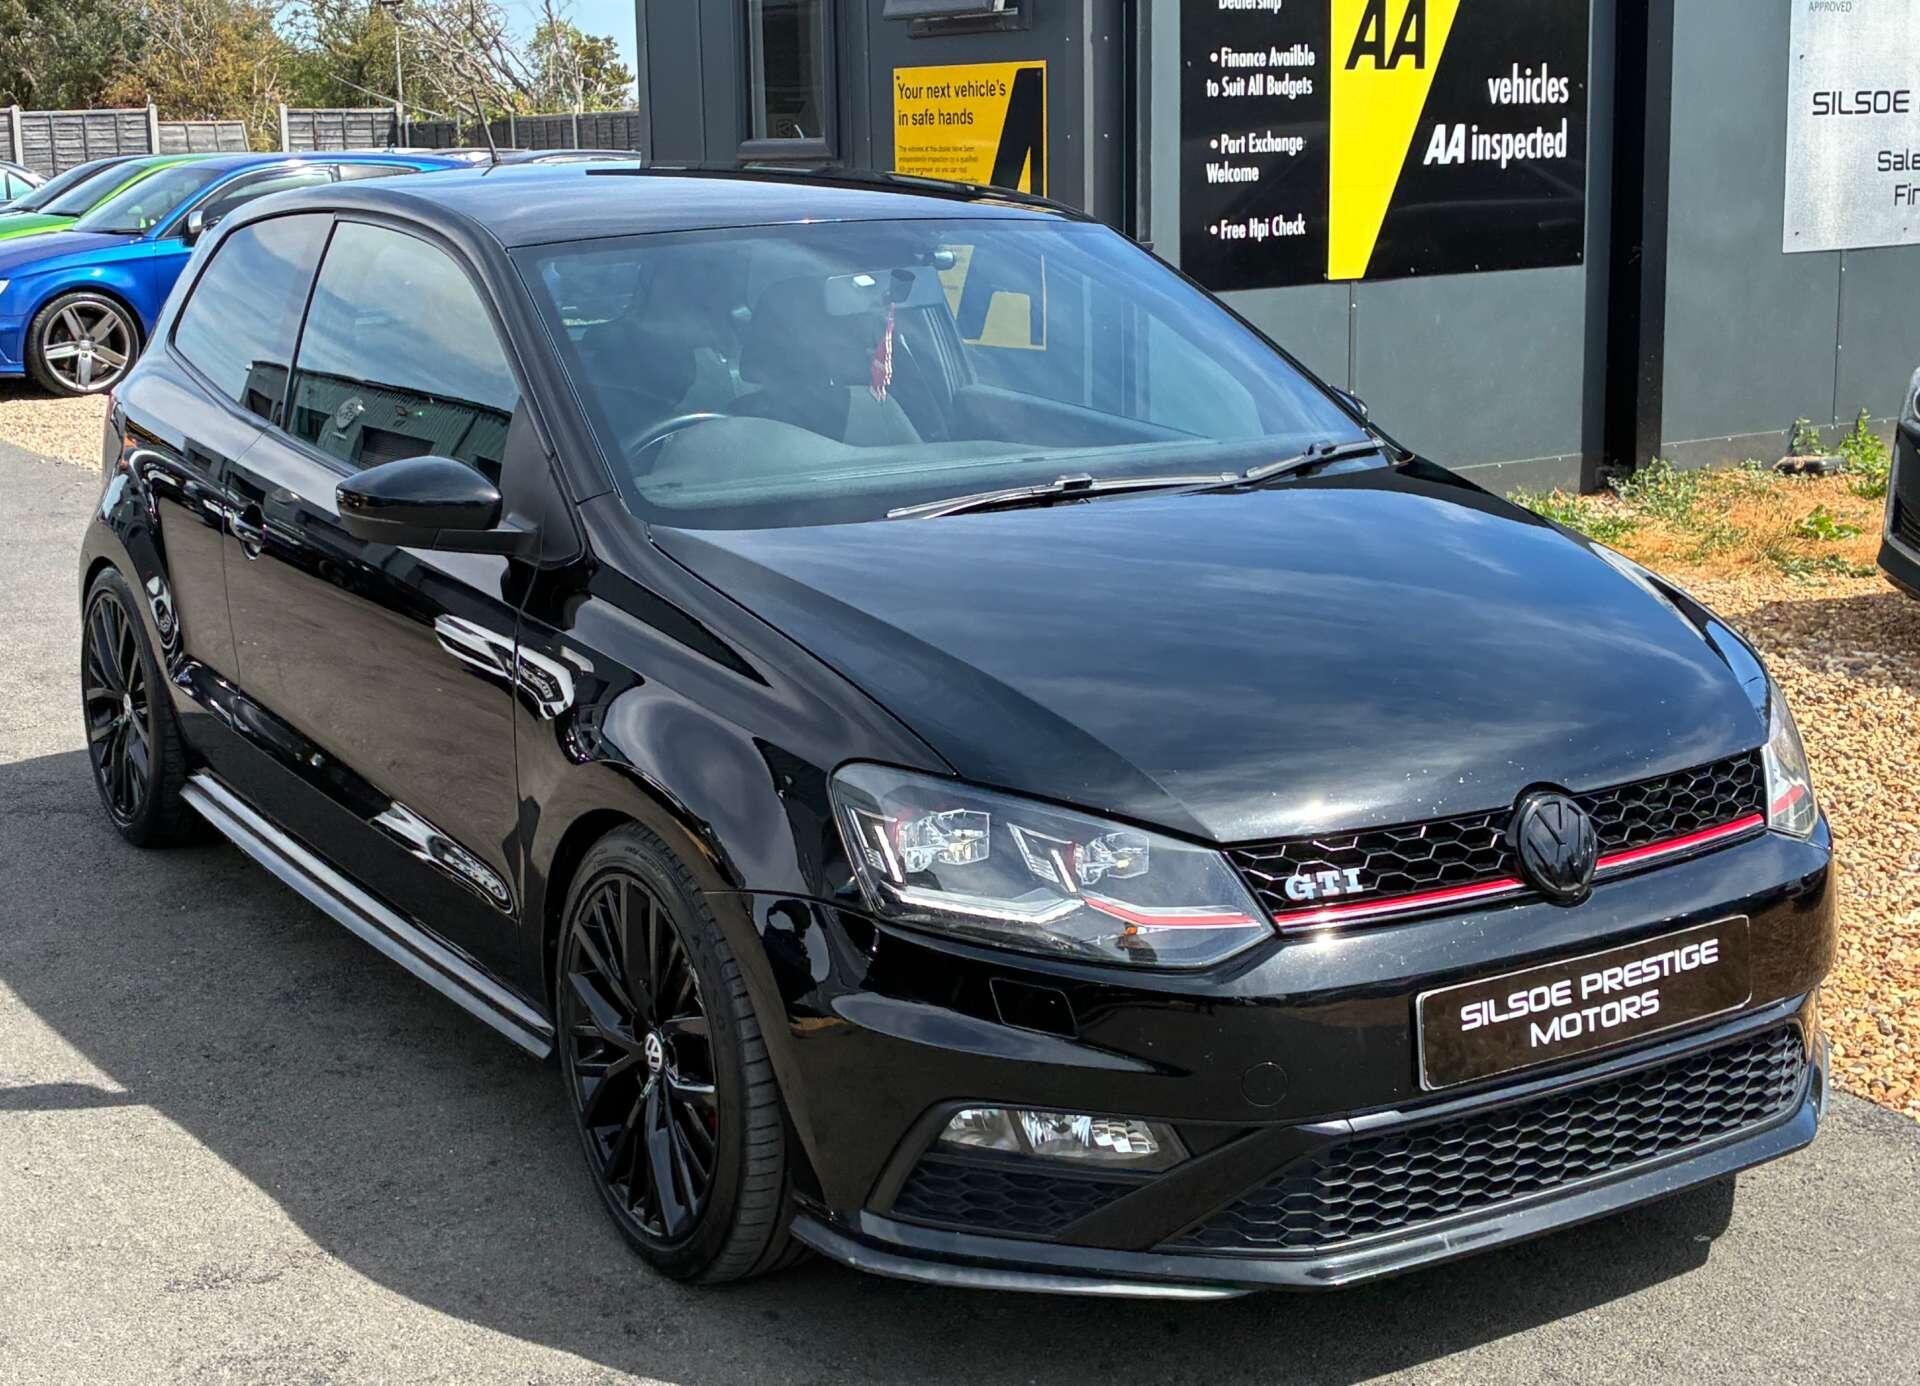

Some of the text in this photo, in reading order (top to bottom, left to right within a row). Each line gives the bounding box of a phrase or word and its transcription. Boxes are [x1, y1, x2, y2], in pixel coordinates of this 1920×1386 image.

[1808, 0, 1852, 12] APPROVED
[1345, 0, 1426, 70] AA
[1221, 43, 1315, 68] Finance Availble
[898, 80, 1006, 99] Your next vehicle's
[1206, 72, 1313, 100] to Suit All Budgets
[1488, 63, 1569, 104] vehicles
[1812, 90, 1910, 115] SILSOE
[898, 108, 974, 126] in safe hands
[1220, 130, 1303, 156] Part Exchange
[1424, 118, 1568, 169] AA inspected
[1206, 160, 1260, 184] Welcome
[1220, 212, 1306, 242] Free Hpi Check
[1284, 867, 1365, 900] GTI
[1461, 938, 1719, 1031] SILSOE PRESTIGE
[1530, 989, 1660, 1048] MOTORS
